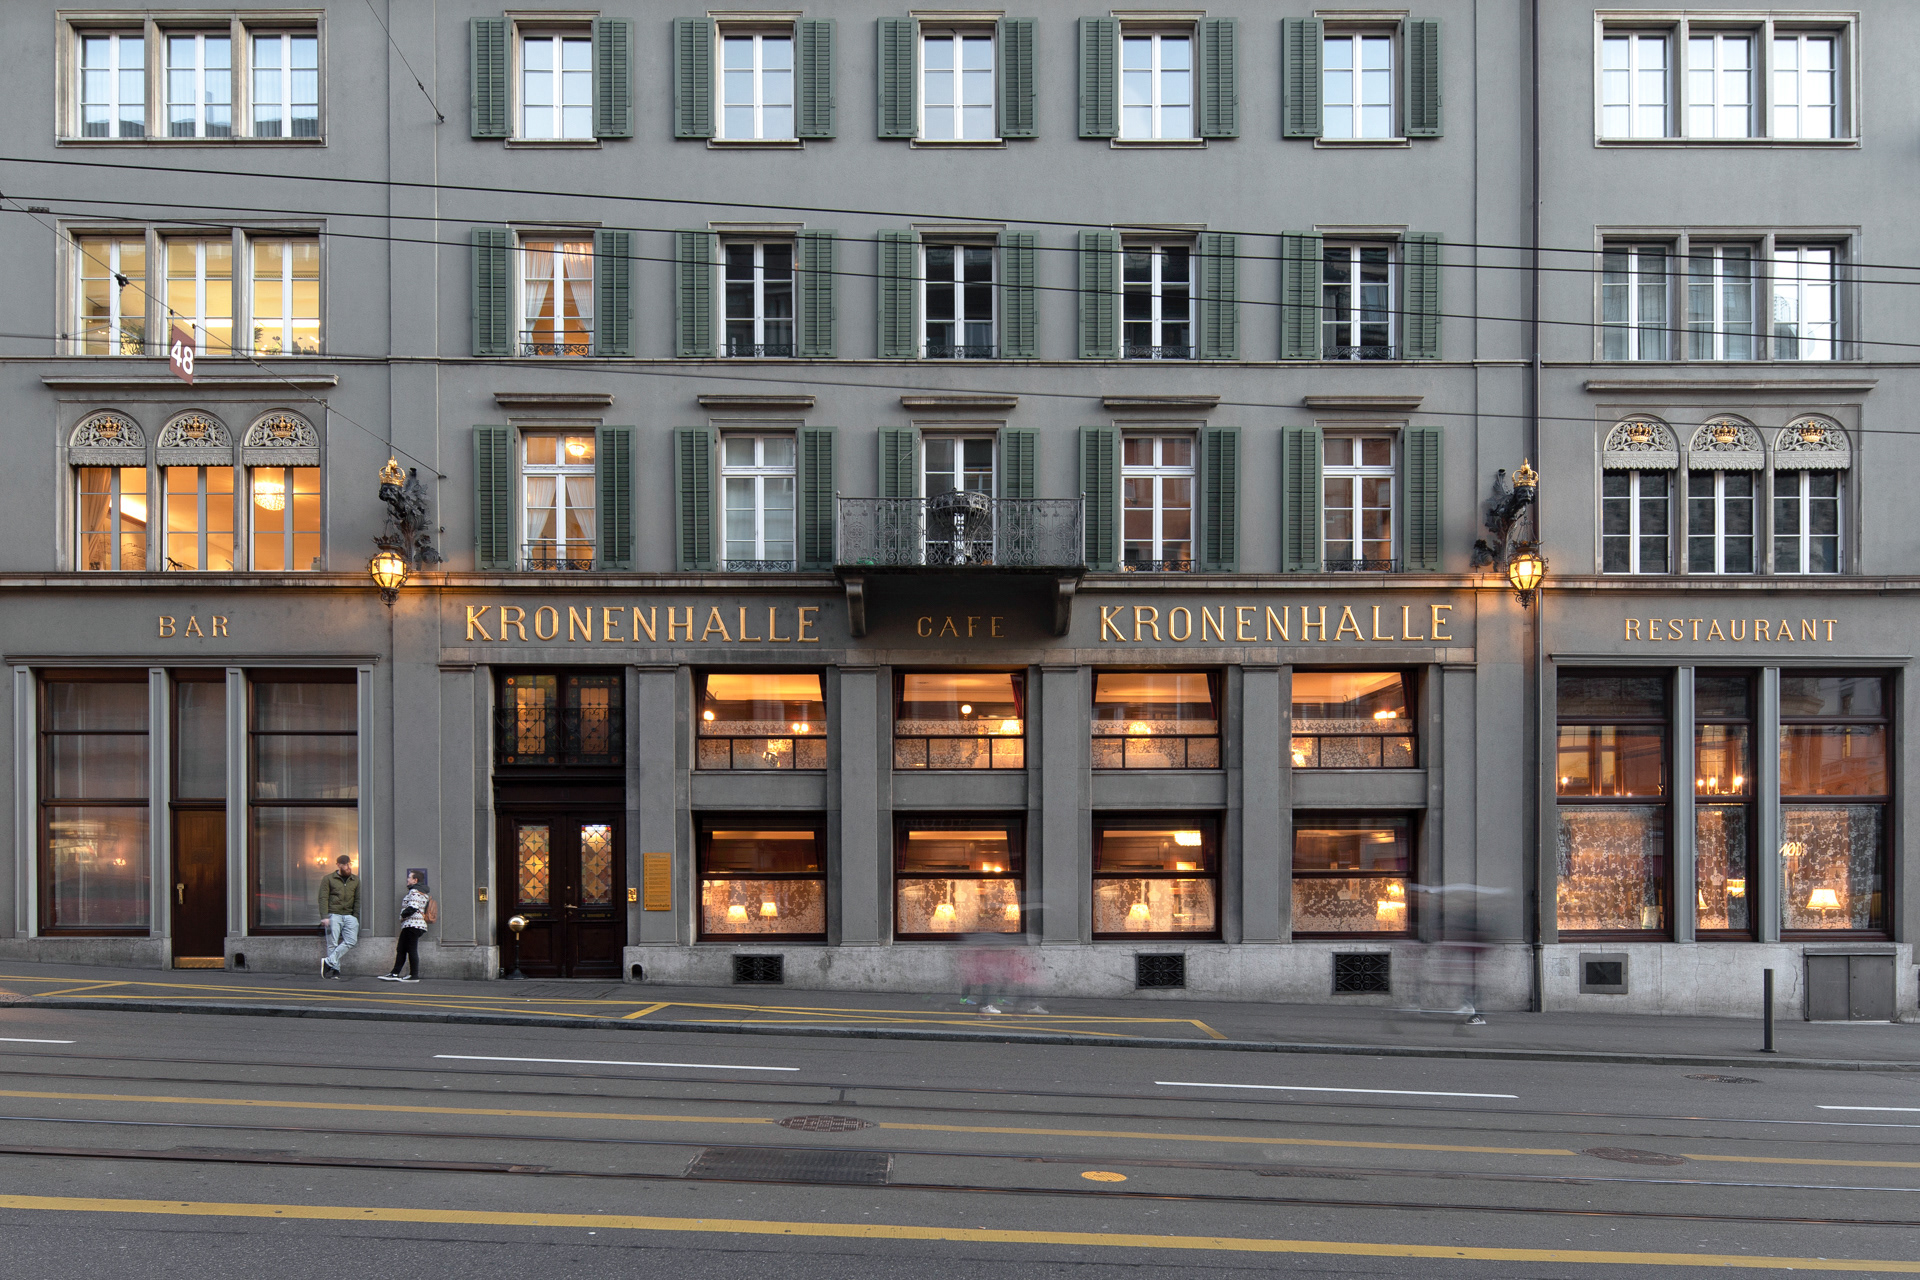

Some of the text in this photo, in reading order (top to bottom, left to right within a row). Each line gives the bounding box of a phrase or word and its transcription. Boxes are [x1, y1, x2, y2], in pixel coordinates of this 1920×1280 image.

[170, 339, 194, 375] 48
[158, 615, 230, 638] BAR
[464, 604, 820, 643] KRONENHALLE
[916, 615, 1005, 638] CAFE
[1098, 604, 1453, 642] KRONENHALLE
[1624, 618, 1838, 642] RESTAURANT
